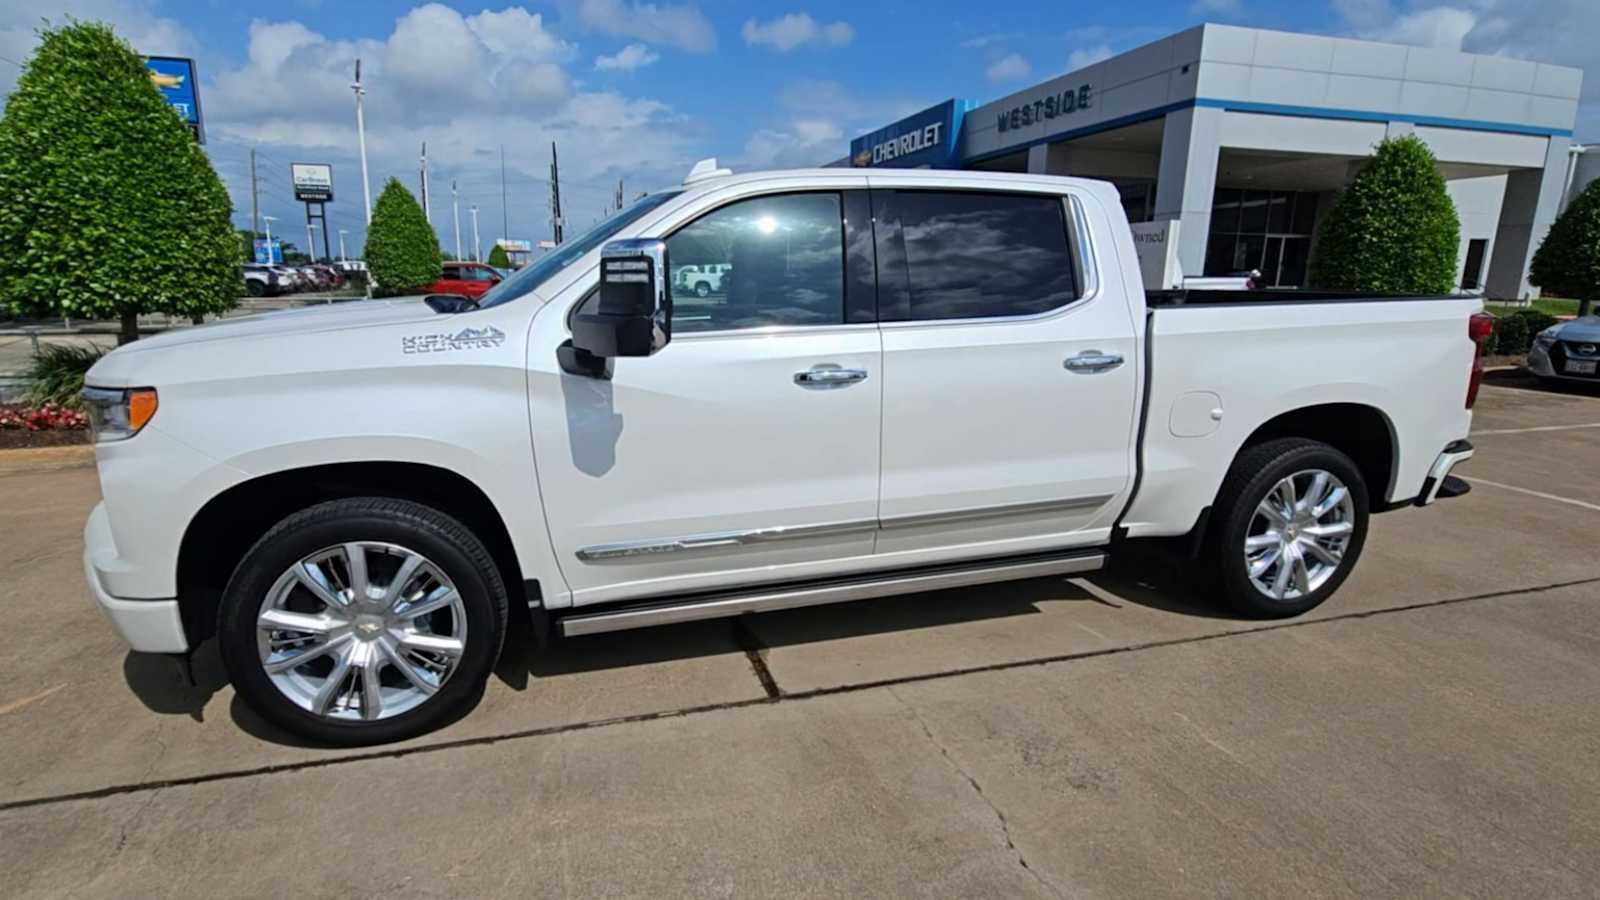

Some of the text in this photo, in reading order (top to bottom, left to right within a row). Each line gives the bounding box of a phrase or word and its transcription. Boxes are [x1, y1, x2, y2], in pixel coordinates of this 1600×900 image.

[997, 84, 1092, 132] WESTSIDE
[873, 122, 944, 164] CHEVROLET
[402, 339, 500, 354] COUNTRY
